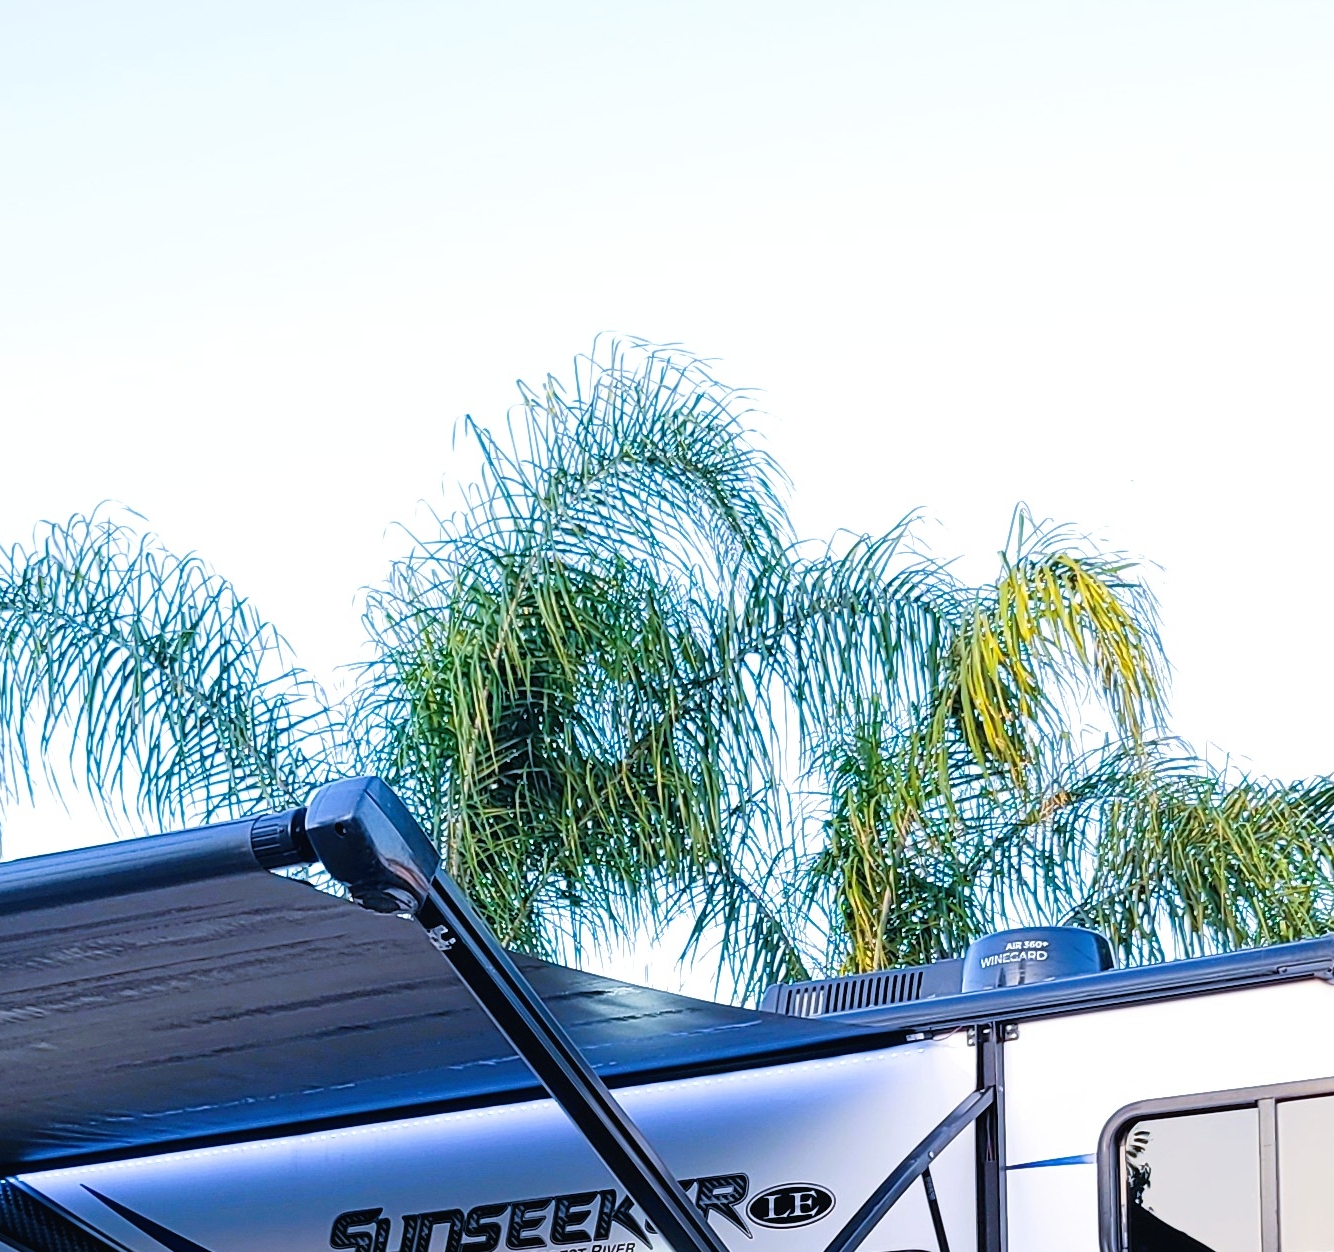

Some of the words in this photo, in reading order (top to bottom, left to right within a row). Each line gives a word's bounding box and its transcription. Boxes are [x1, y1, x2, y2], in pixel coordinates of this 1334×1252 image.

[1005, 941, 1022, 950] AIR
[980, 950, 1048, 968] WINEGARD
[762, 1190, 820, 1220] LE
